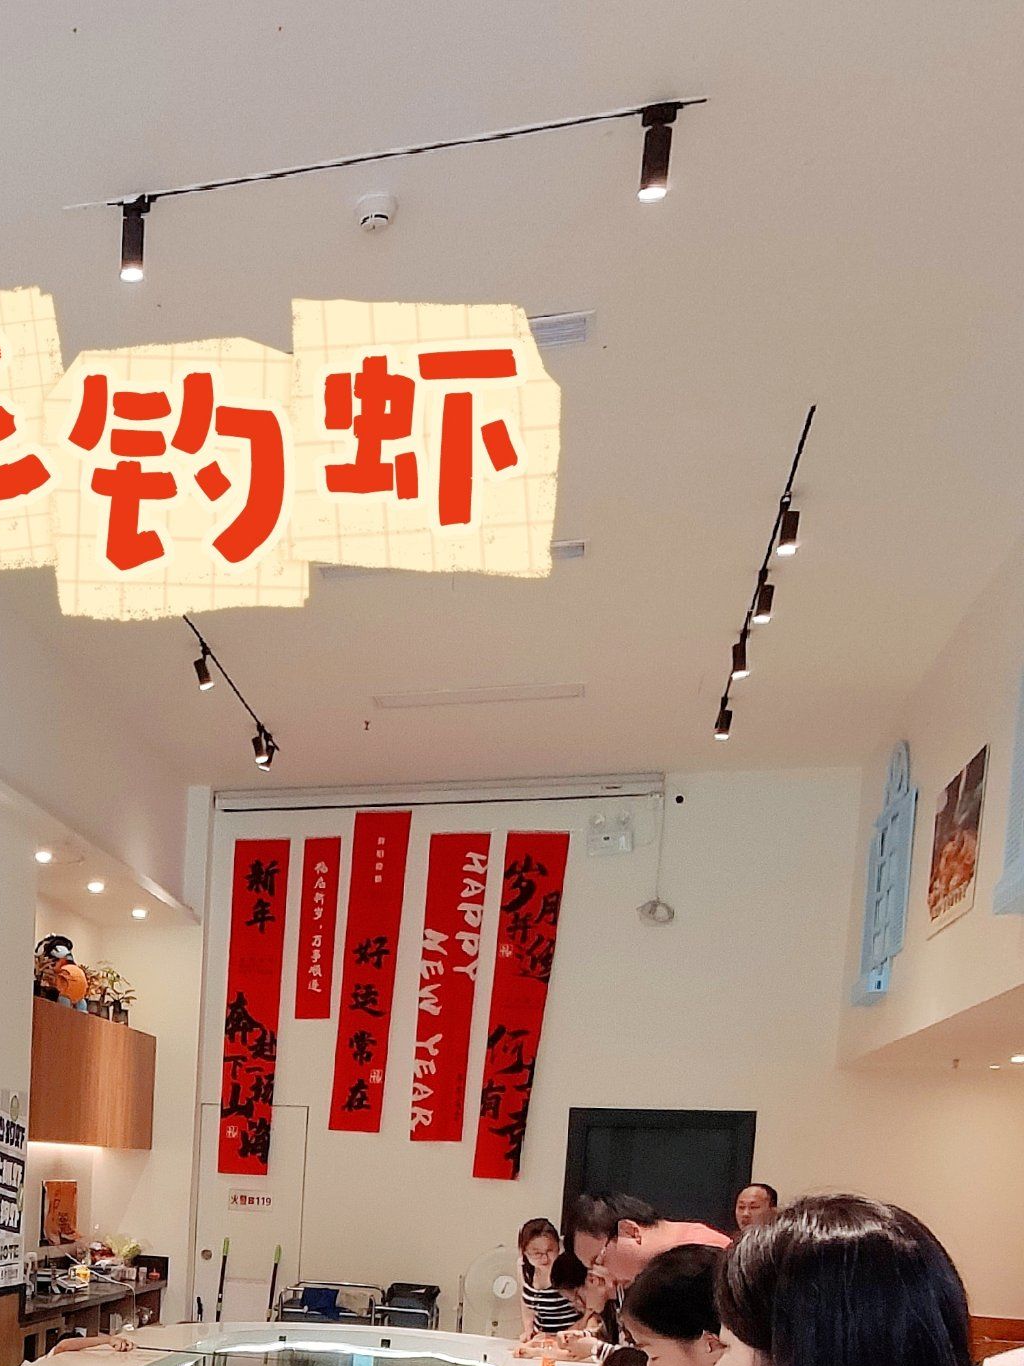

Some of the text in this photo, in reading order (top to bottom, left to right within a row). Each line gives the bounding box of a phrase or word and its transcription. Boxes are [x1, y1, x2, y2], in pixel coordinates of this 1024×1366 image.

[244, 859, 280, 933] 新年
[453, 852, 488, 981] HAPPY
[341, 936, 390, 1111] 好运常在
[410, 1033, 443, 1132] YEAR
